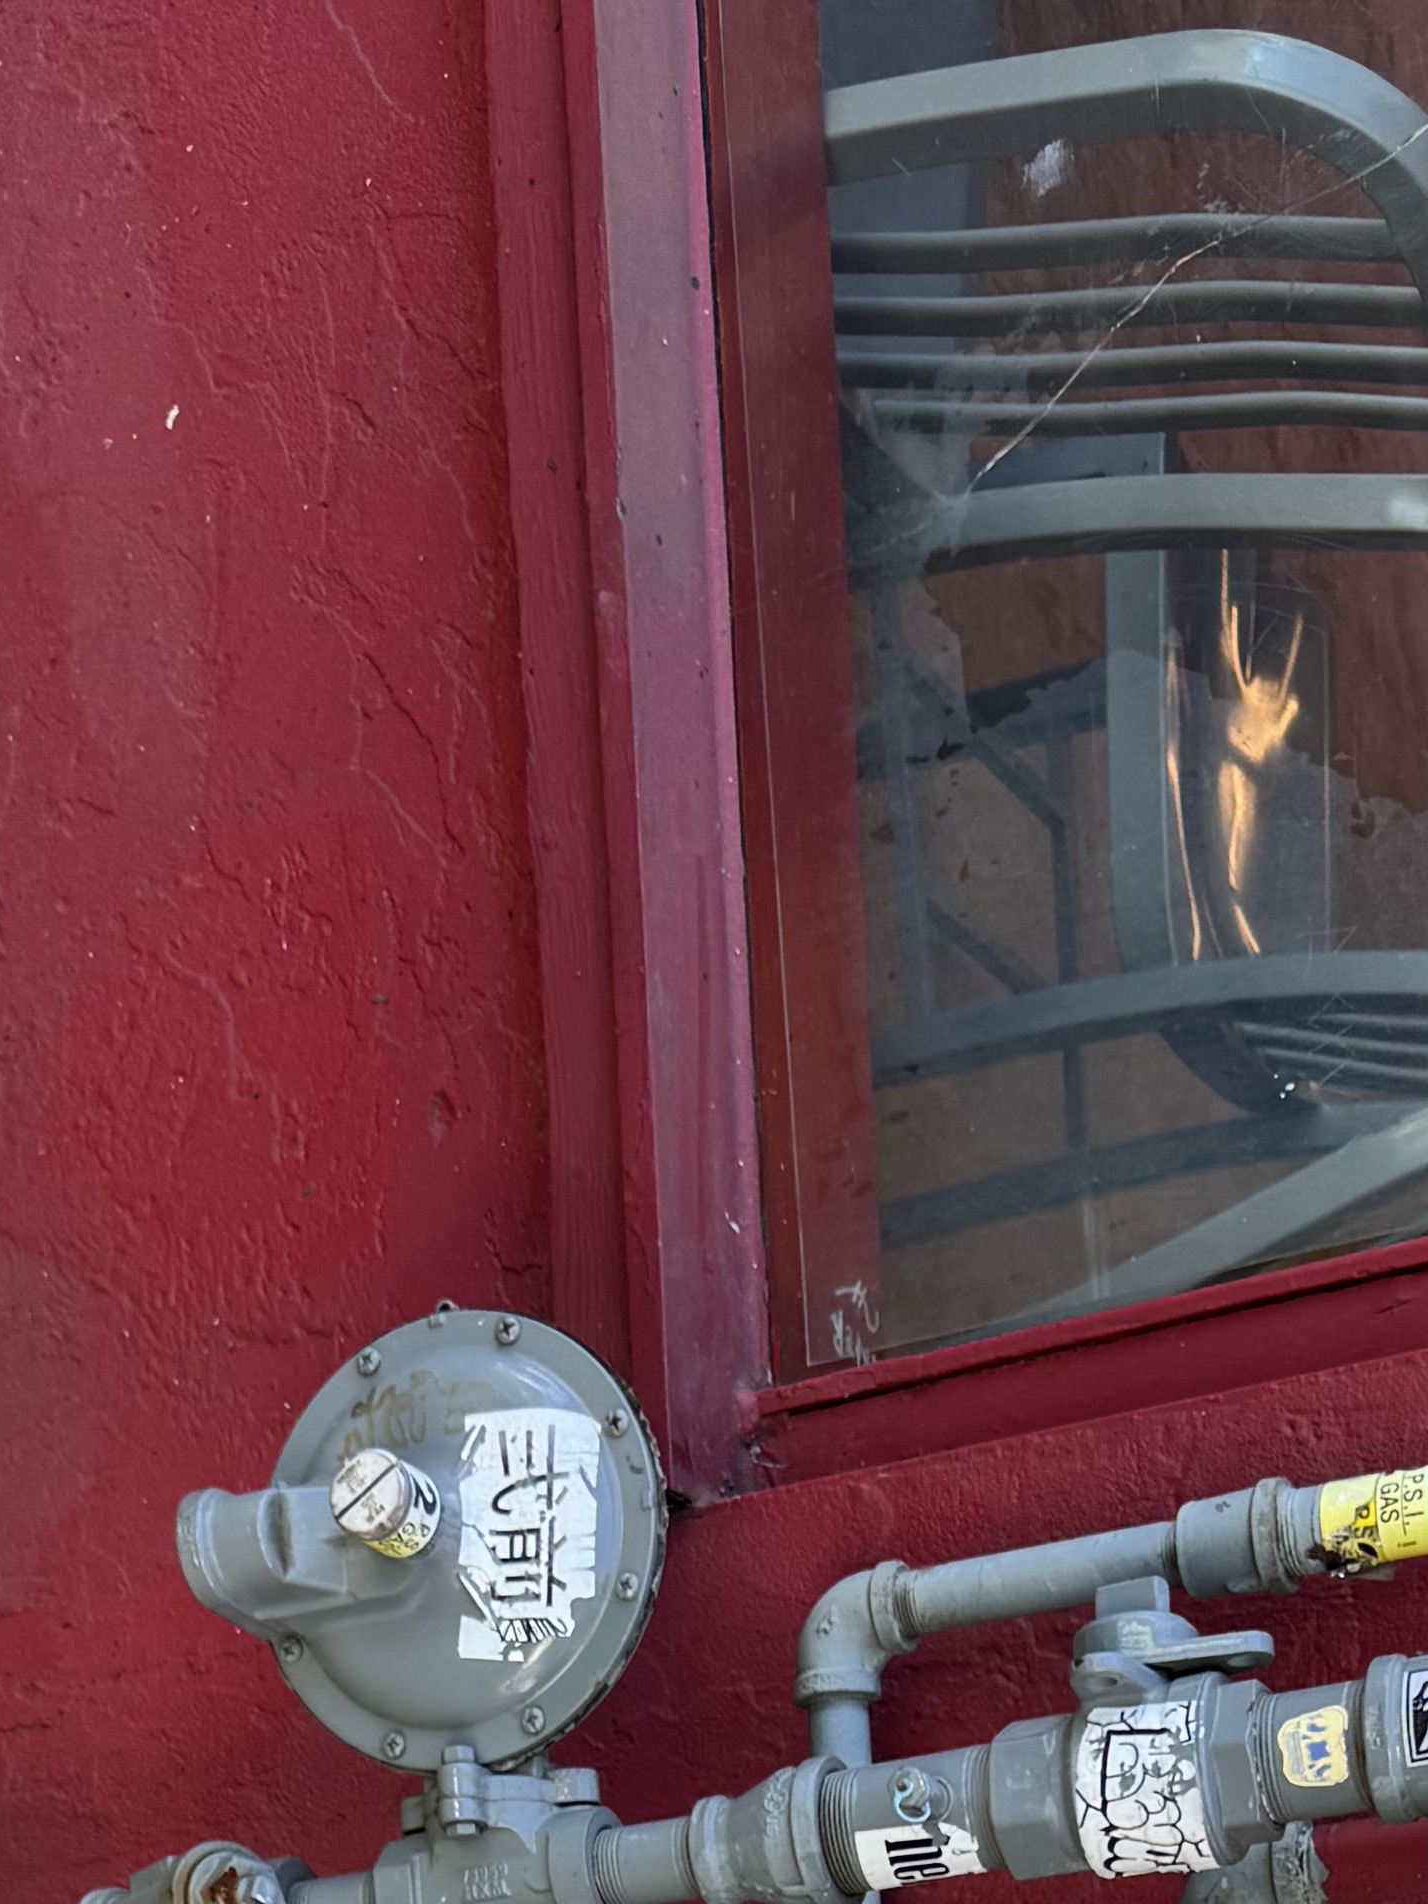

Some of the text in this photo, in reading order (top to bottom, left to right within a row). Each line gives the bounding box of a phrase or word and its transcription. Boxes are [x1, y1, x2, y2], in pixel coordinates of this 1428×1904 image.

[410, 1473, 438, 1516] 2
[1379, 1482, 1400, 1524] GAS
[1403, 1473, 1425, 1526] P.S.I.
